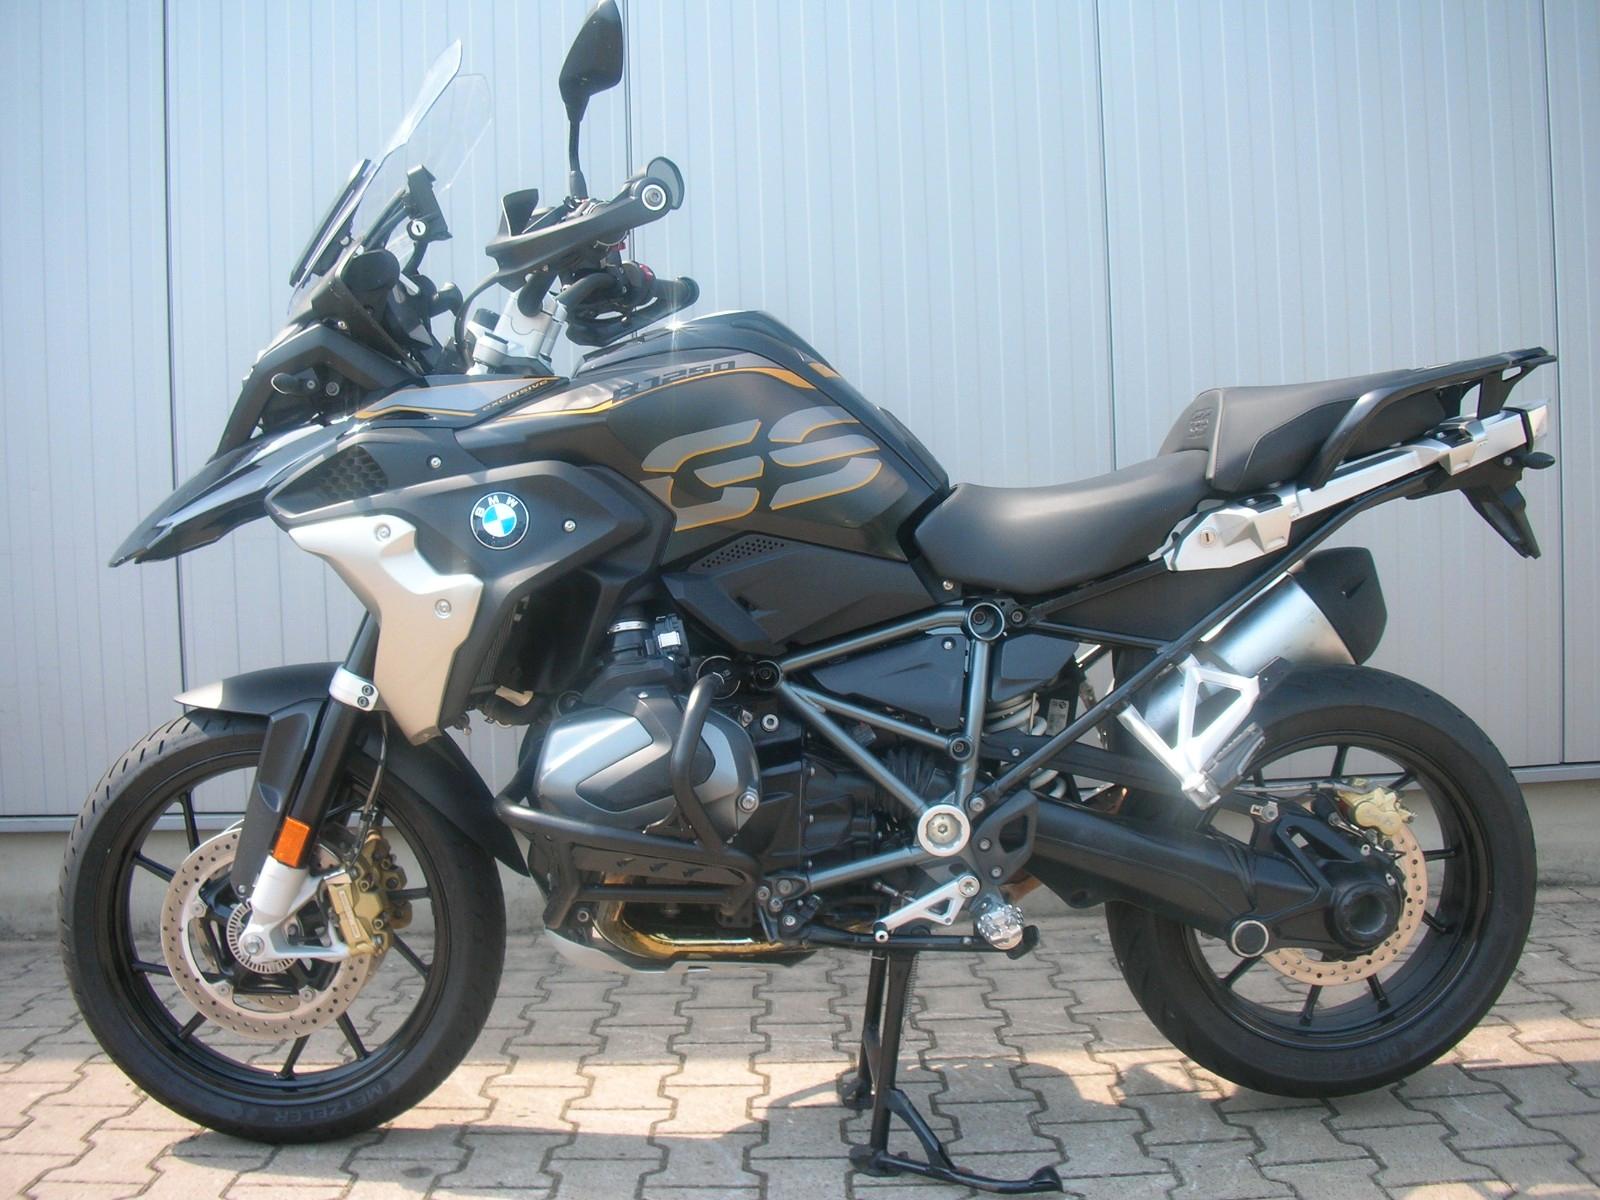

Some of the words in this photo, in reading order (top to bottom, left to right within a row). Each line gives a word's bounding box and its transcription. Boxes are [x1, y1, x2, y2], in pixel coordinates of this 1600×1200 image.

[643, 360, 736, 388] 1250
[640, 406, 883, 532] GS
[474, 494, 519, 518] BMW
[274, 1084, 383, 1122] METZELER
